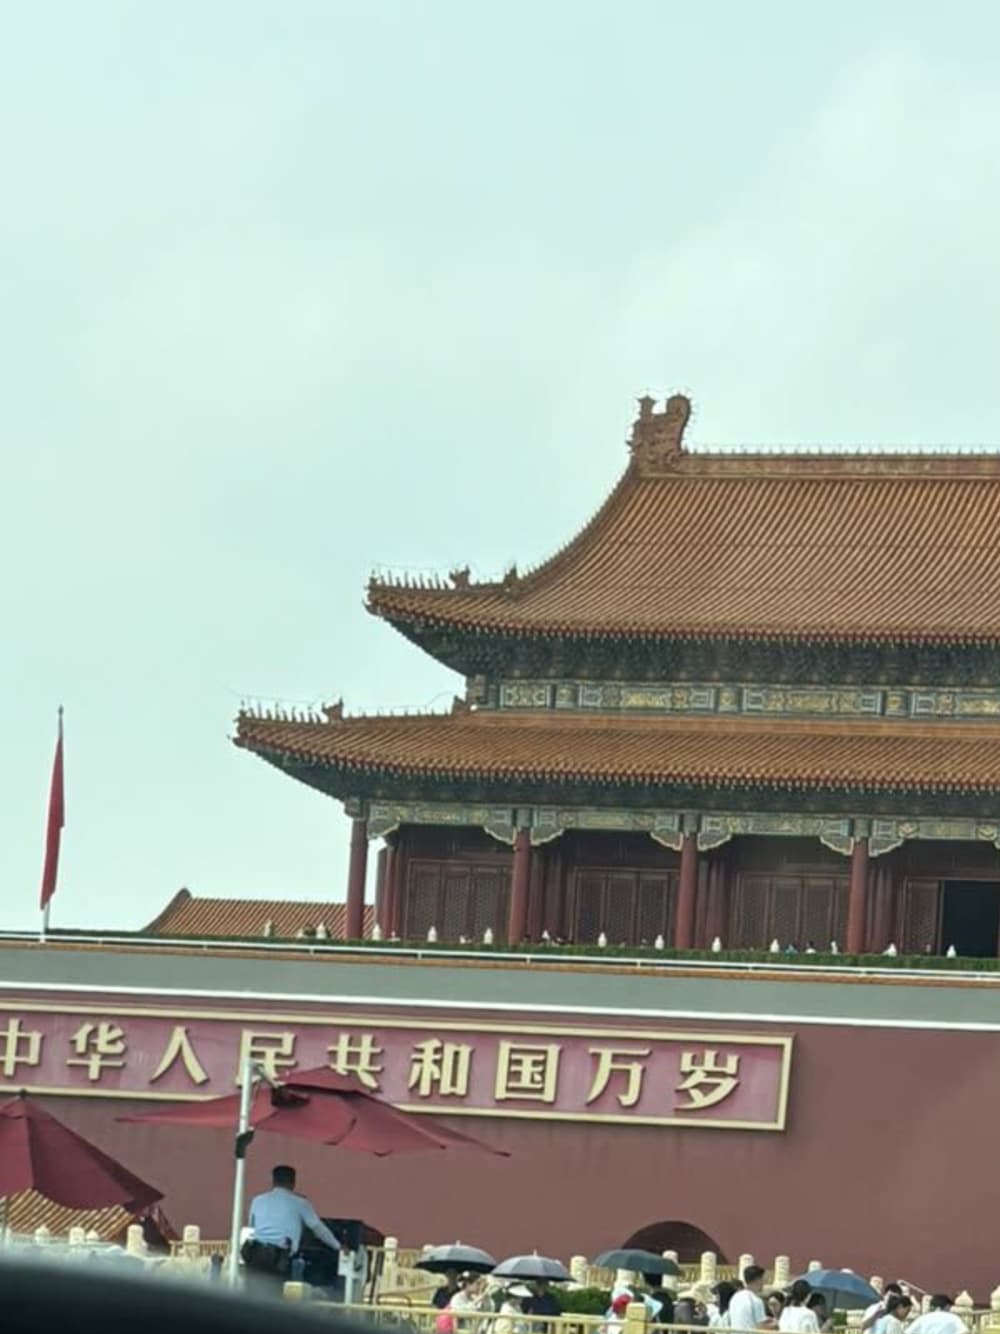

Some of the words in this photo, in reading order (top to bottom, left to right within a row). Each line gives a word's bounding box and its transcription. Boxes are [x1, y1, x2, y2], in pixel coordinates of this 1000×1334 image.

[0, 1018, 741, 1110] 中华人民共和国万岁
